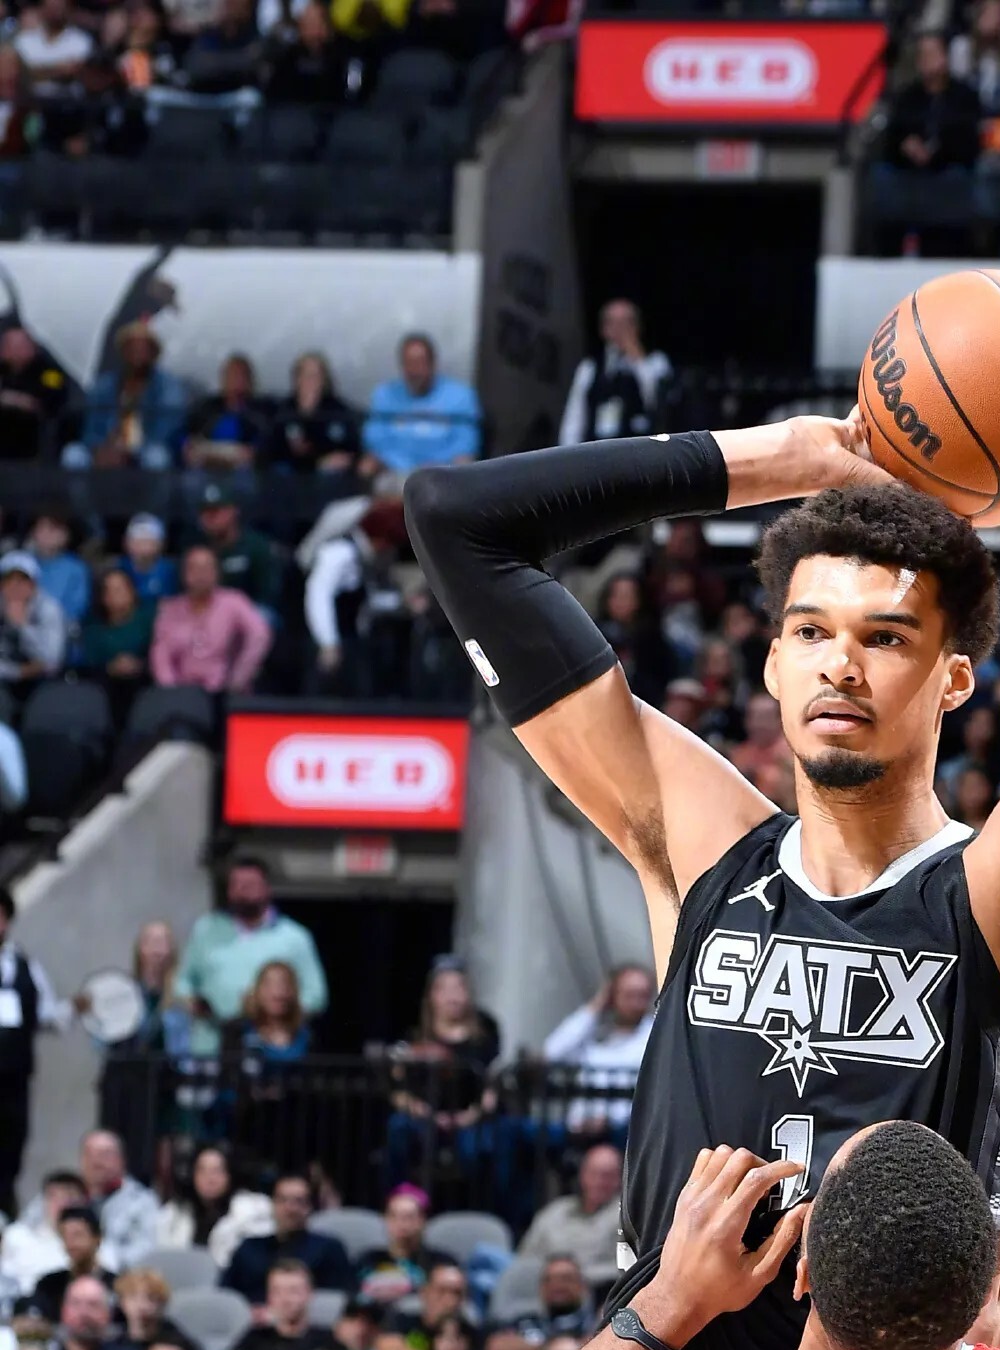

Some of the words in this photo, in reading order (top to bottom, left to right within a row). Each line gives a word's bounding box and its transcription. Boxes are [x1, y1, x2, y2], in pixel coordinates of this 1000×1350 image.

[870, 307, 943, 464] Wilson
[687, 929, 958, 1068] SATX
[768, 1114, 814, 1211] 1
